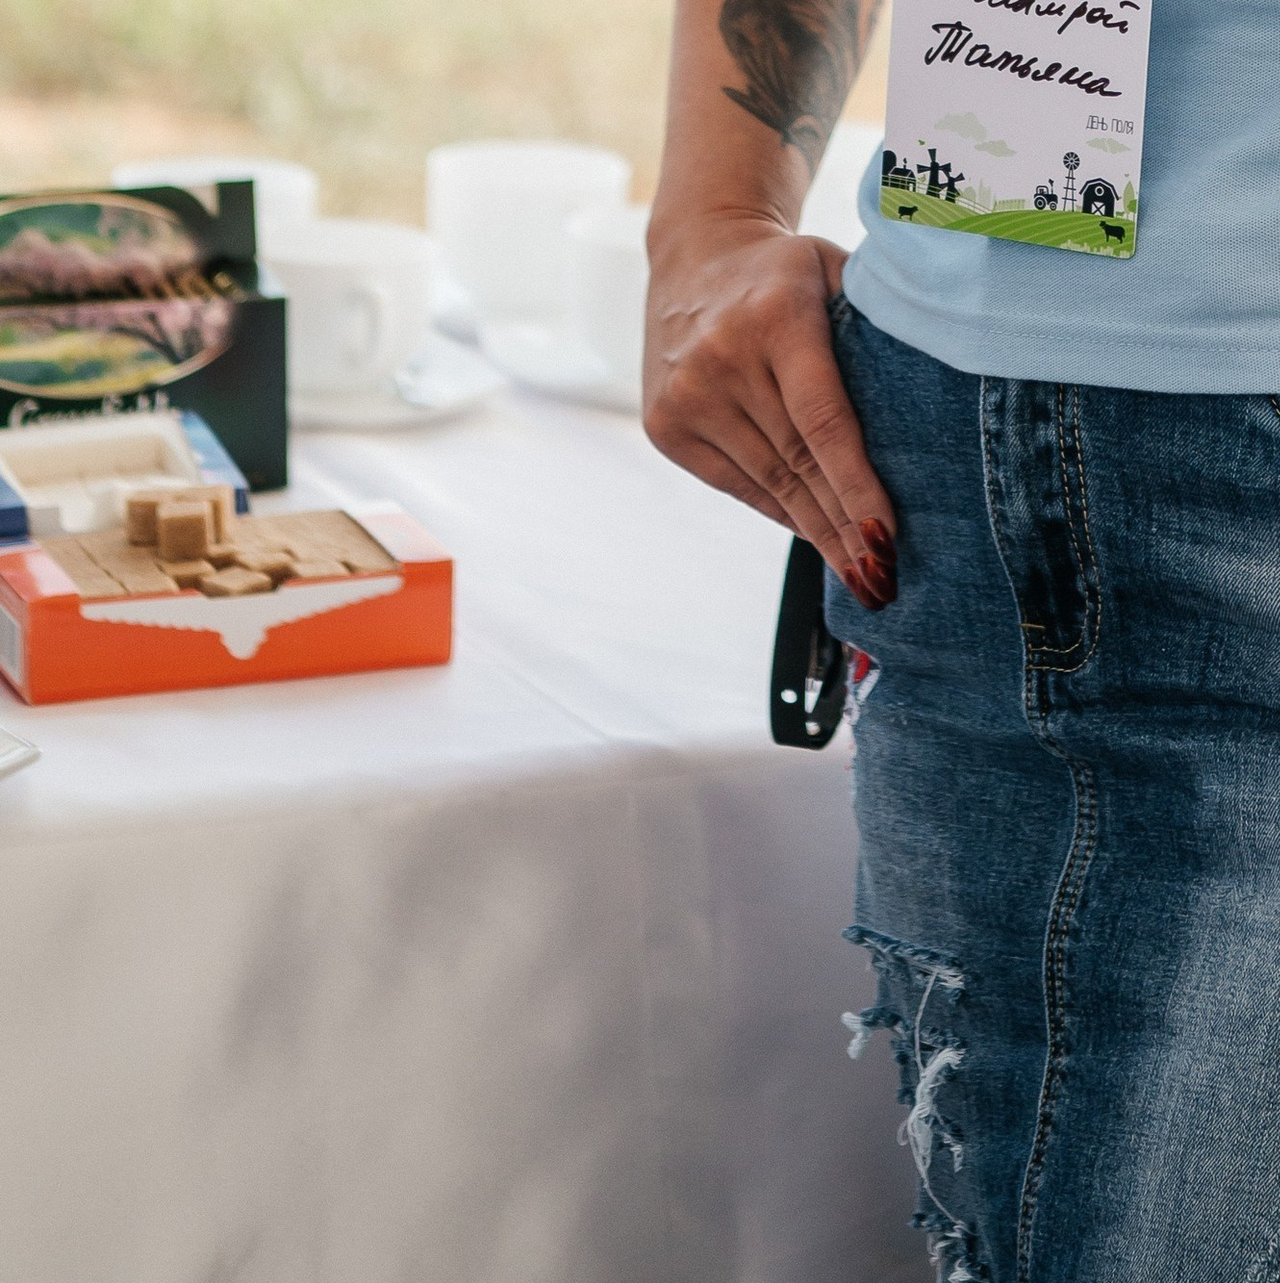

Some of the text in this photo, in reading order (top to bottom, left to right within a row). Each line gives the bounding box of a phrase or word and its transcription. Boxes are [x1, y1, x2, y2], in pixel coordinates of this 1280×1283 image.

[924, 21, 1123, 97] Татьяна
[1086, 115, 1134, 135] ДЕНЬ ПОЛЯ
